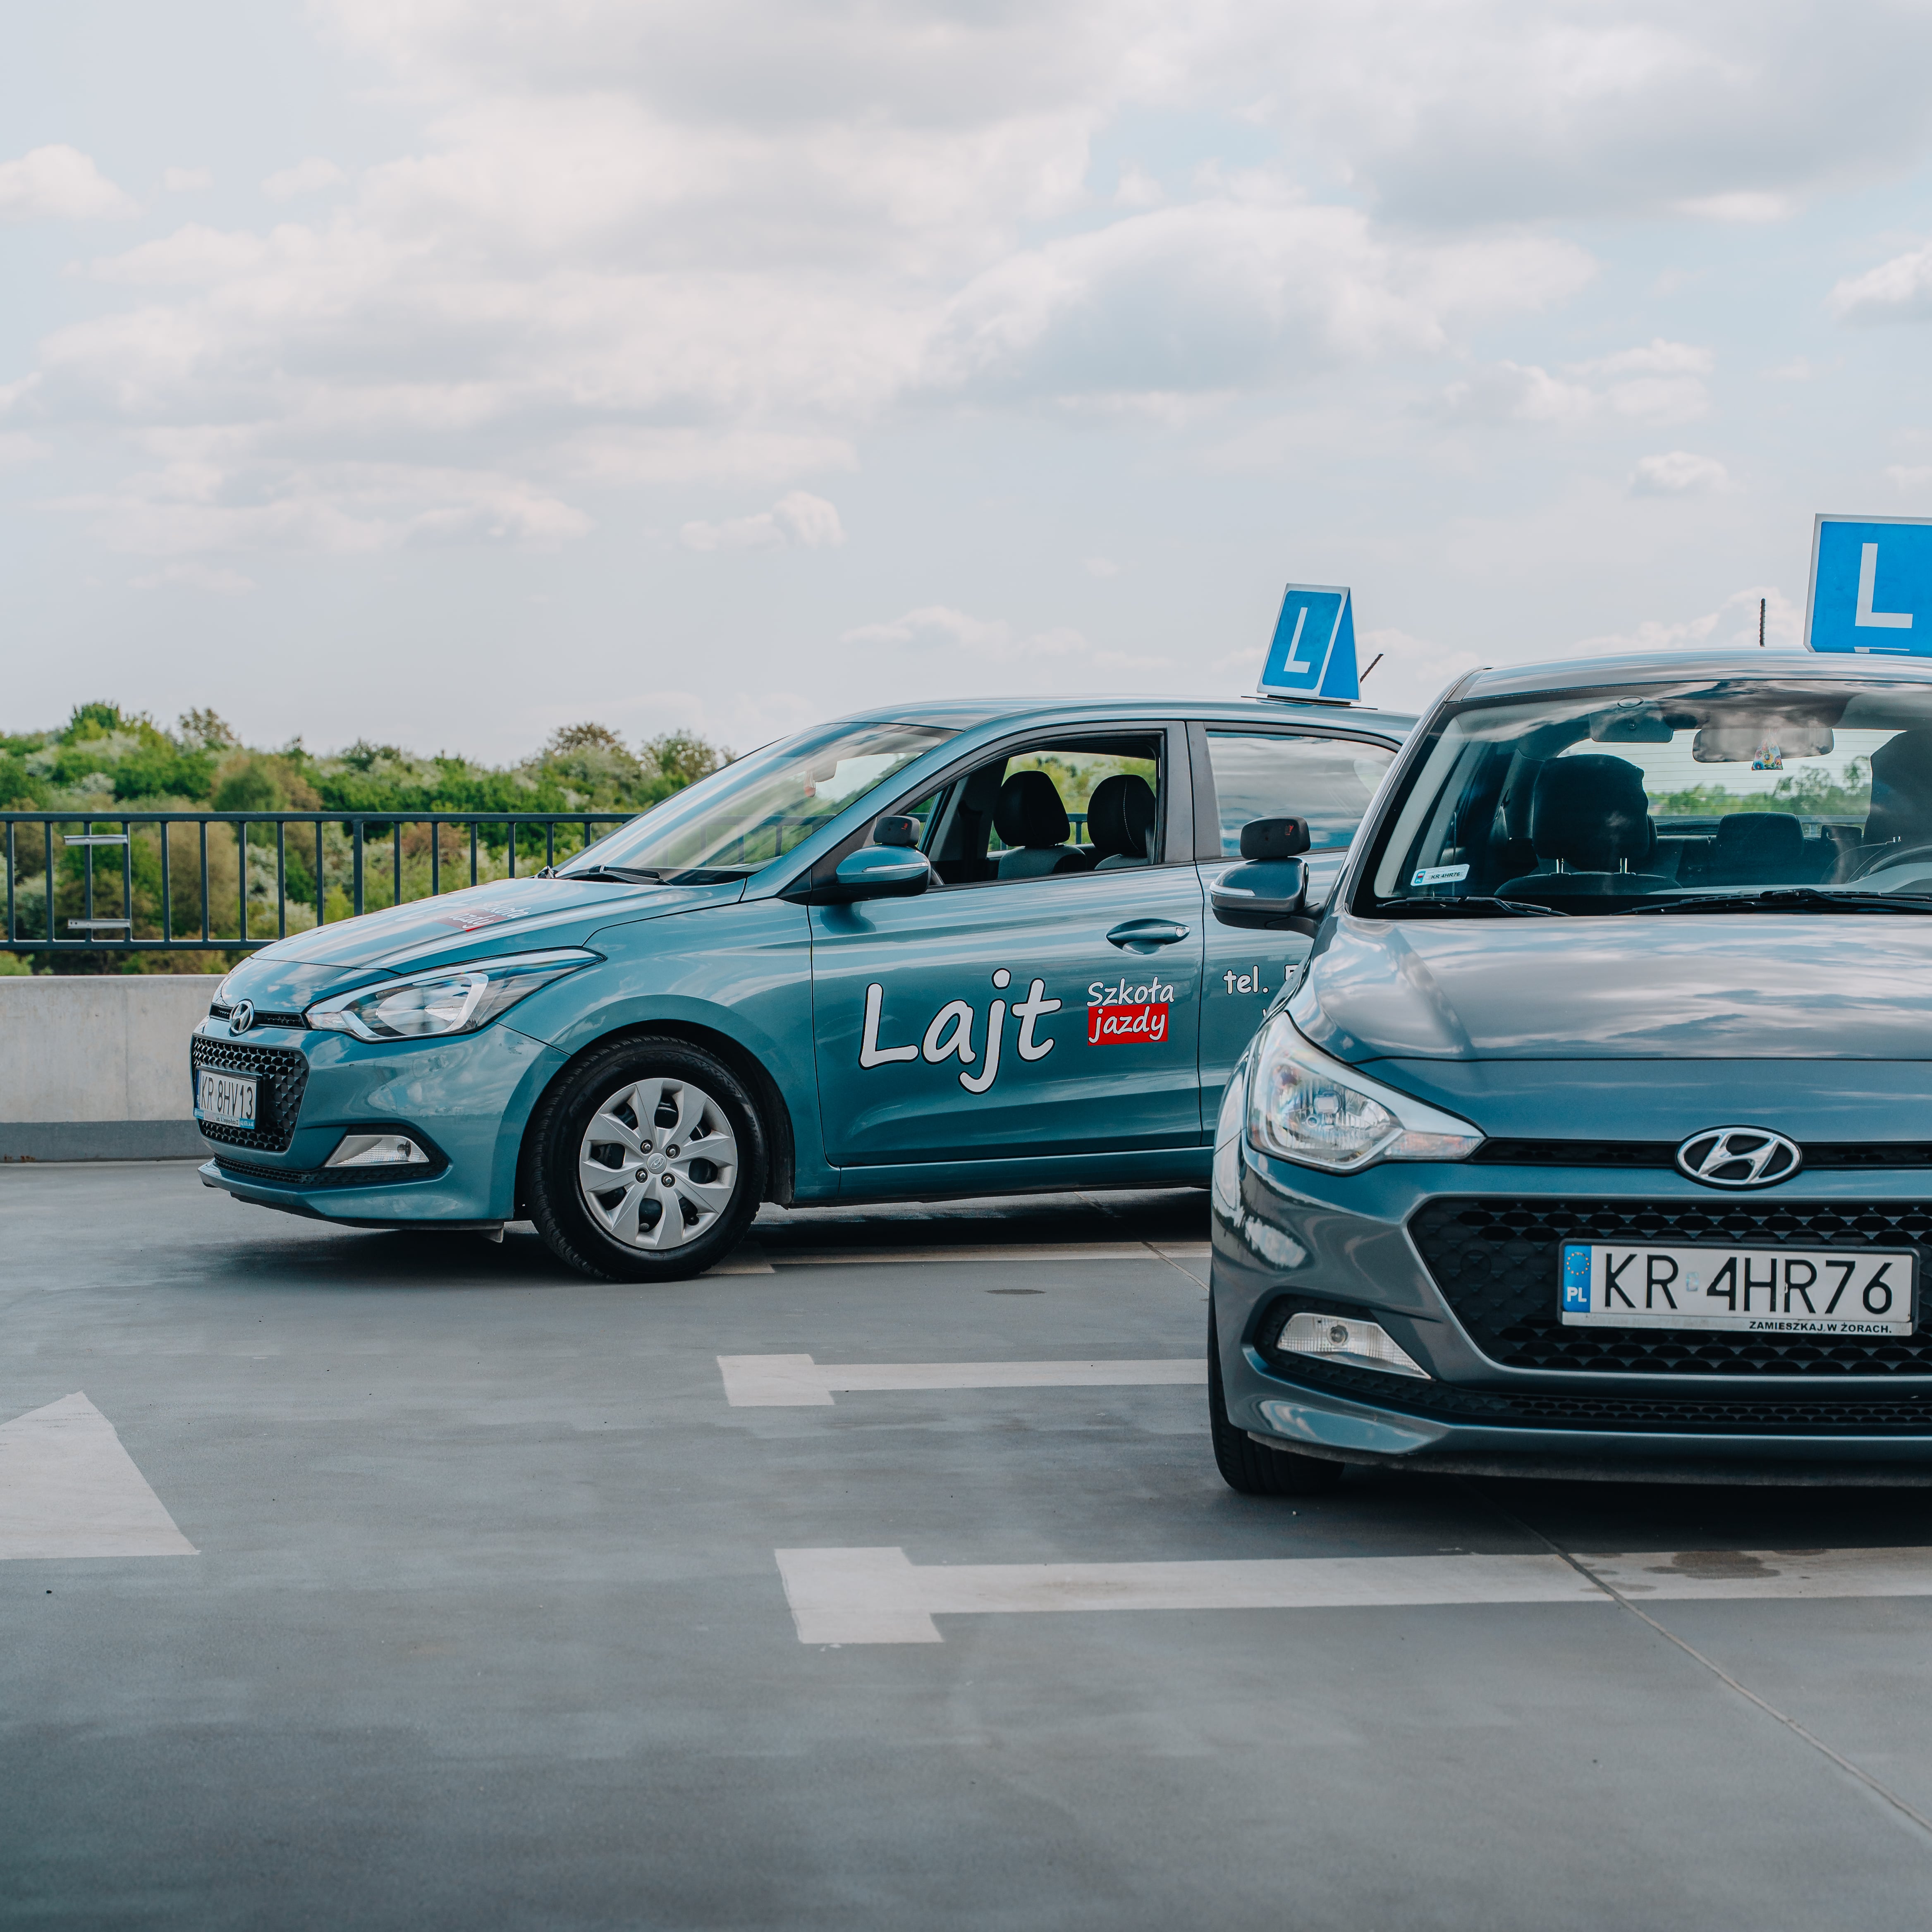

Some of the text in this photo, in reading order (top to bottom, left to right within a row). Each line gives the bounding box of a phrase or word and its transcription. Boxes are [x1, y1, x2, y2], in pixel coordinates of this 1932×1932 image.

[1855, 543, 1913, 628] L
[1283, 607, 1311, 674] L
[1087, 976, 1174, 1007] Szkoła
[1222, 965, 1269, 995] tel.
[859, 968, 1062, 1094] Lajt
[1088, 1006, 1166, 1043] jazdy
[201, 1075, 253, 1119] KR 8HV13
[1567, 1286, 1587, 1302] PL
[1604, 1253, 1893, 1315] KR 4HR76
[1841, 1322, 1892, 1333] ŻORACH.
